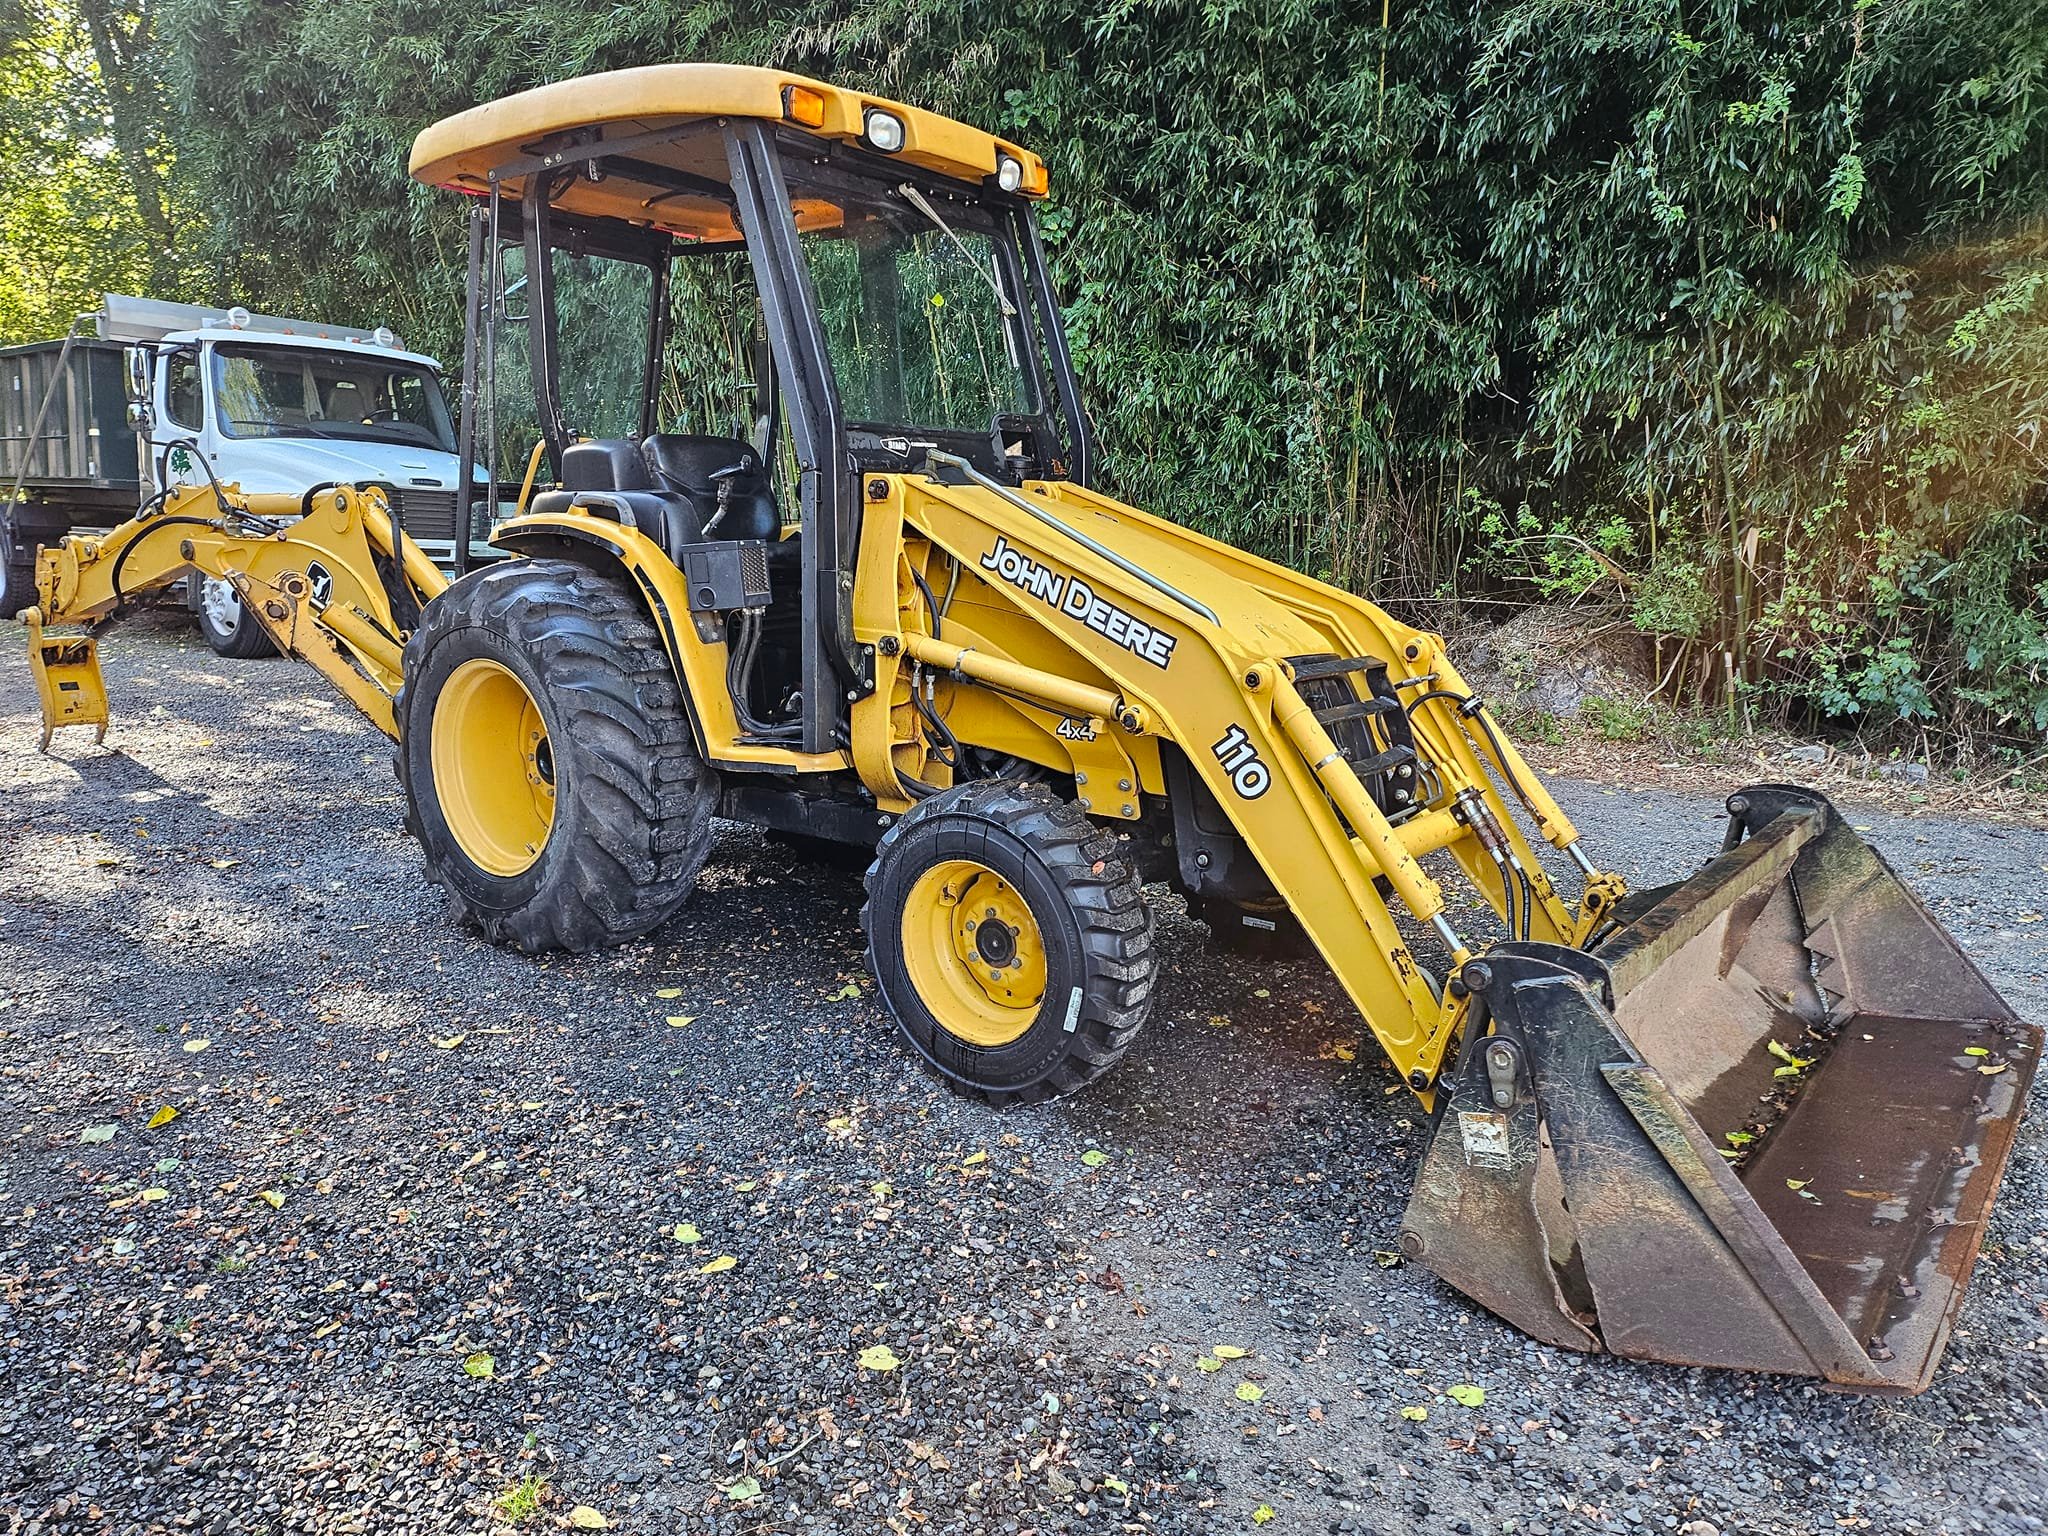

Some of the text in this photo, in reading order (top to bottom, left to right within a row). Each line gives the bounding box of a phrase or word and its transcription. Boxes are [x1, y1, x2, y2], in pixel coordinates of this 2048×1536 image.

[980, 536, 1177, 670] JOHN DEERE
[1056, 717, 1096, 742] 4x4
[1211, 723, 1271, 800] 110
